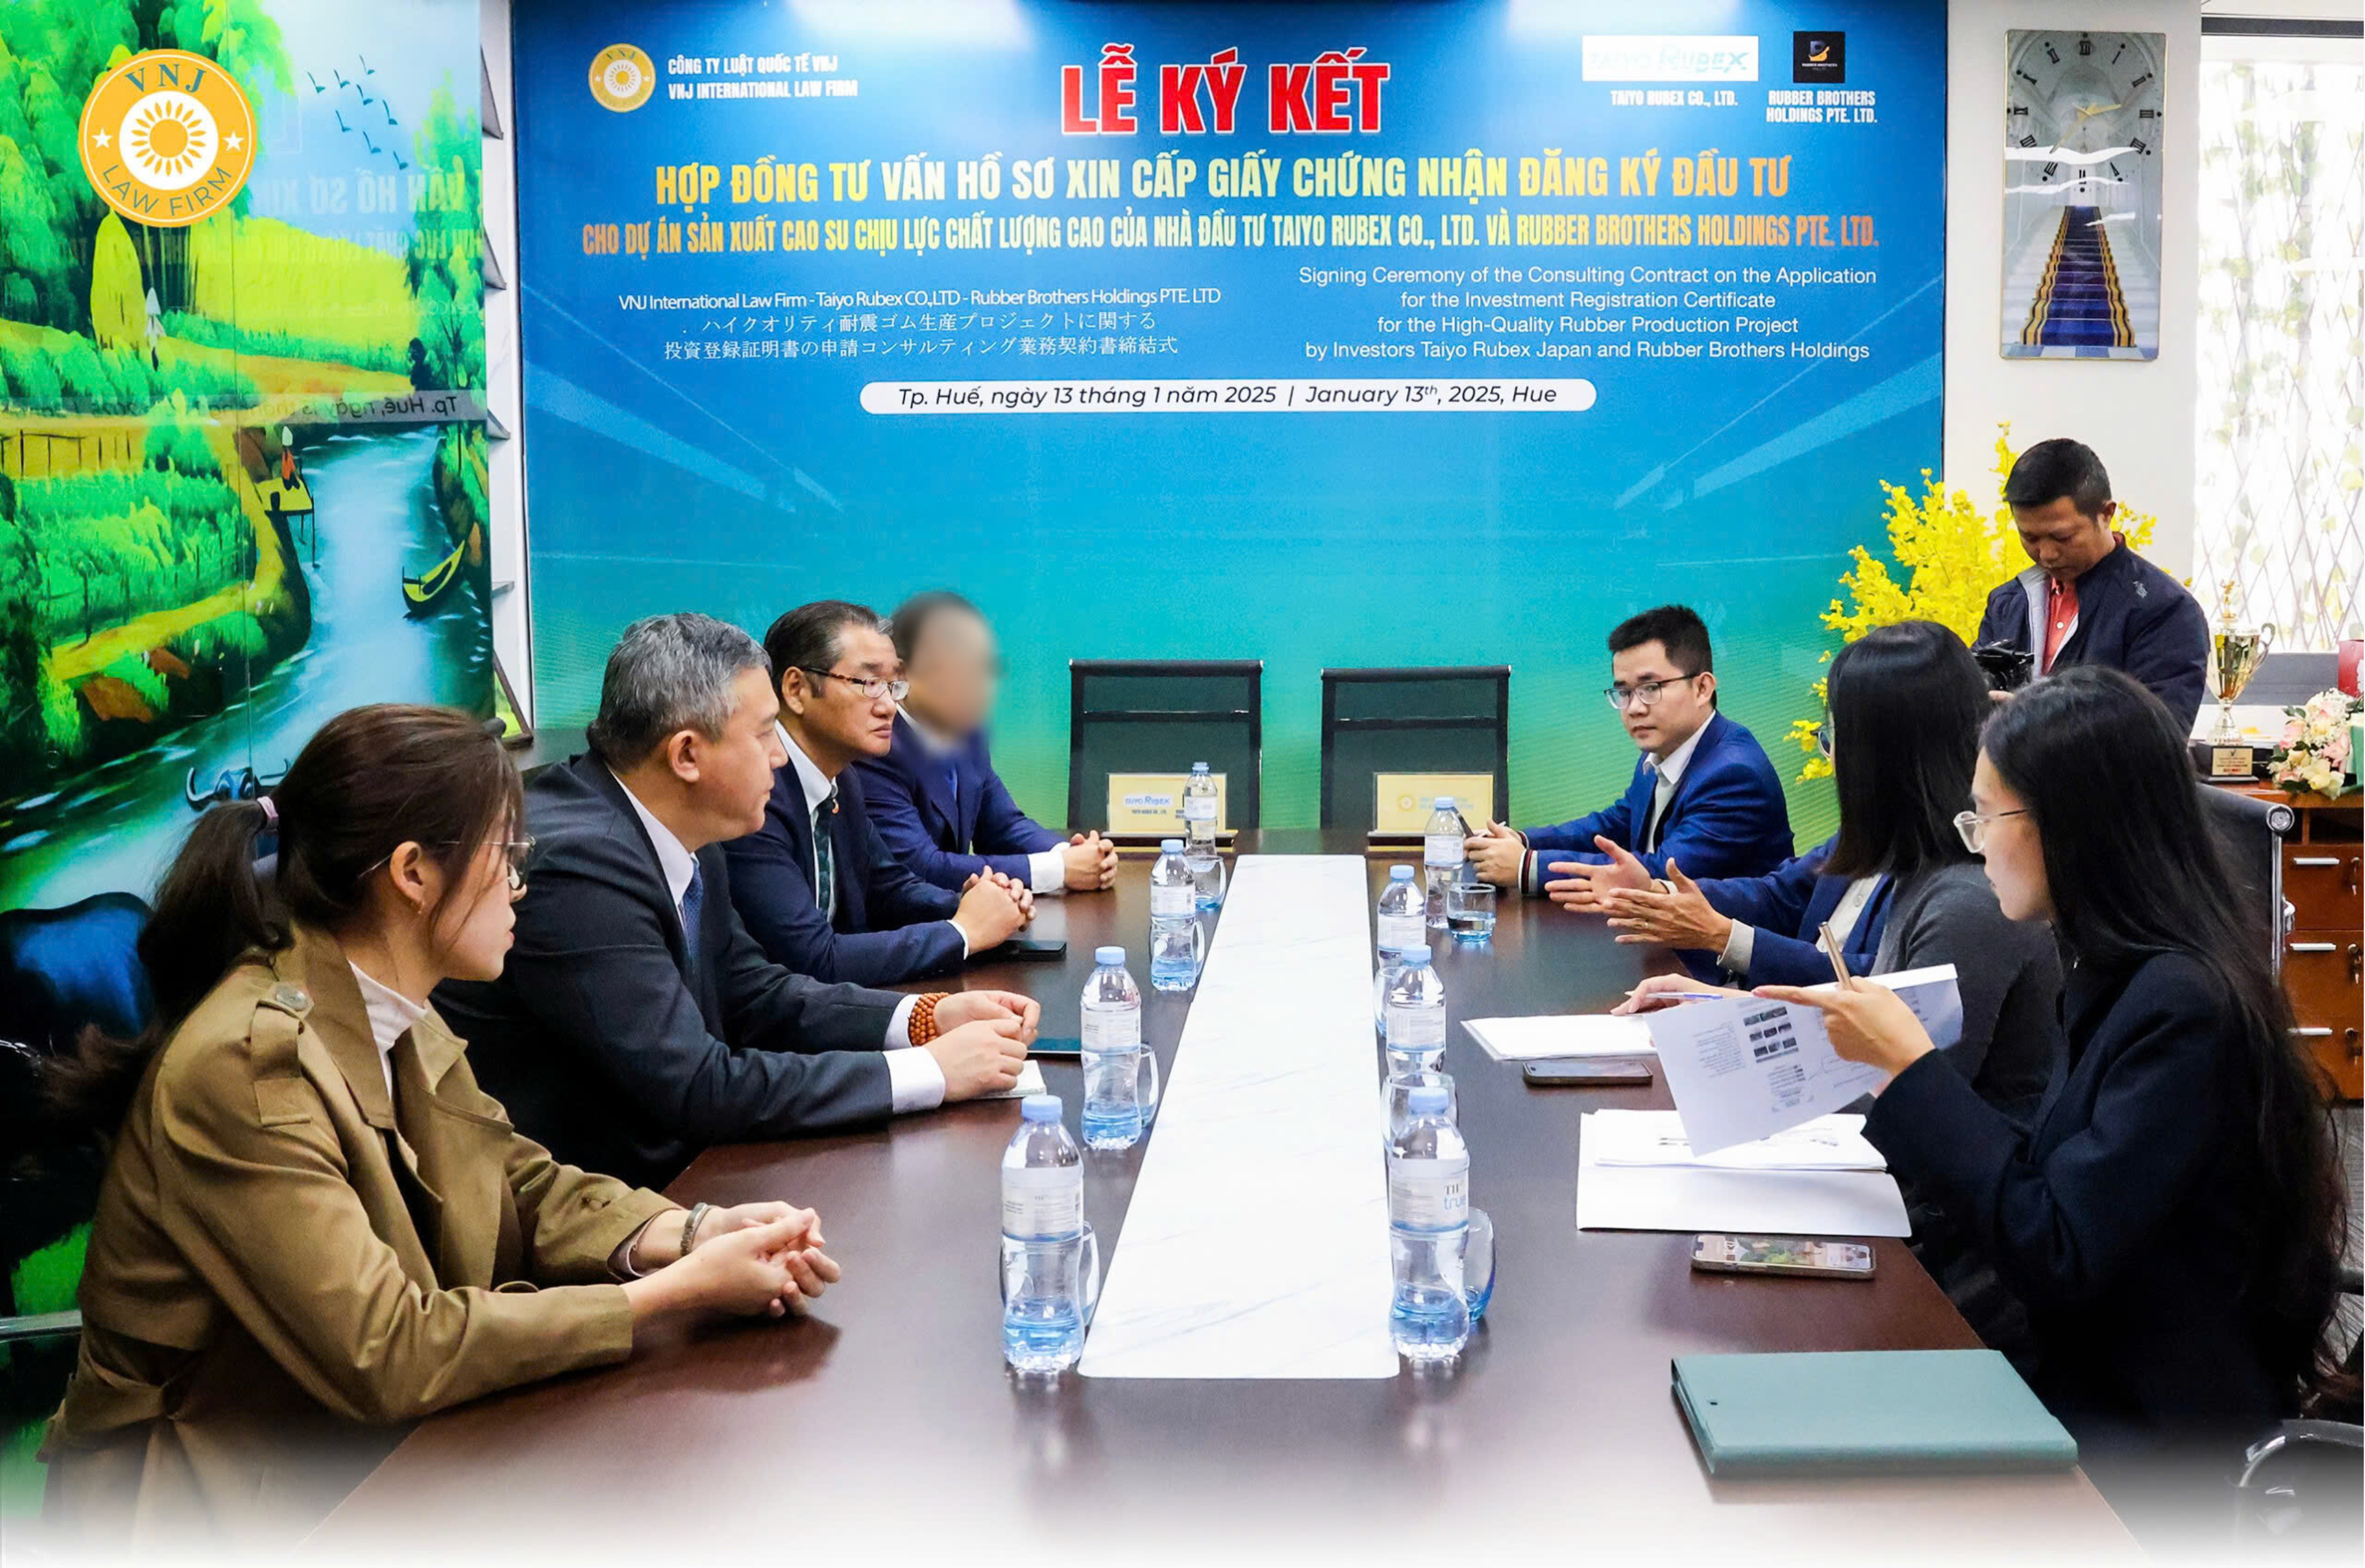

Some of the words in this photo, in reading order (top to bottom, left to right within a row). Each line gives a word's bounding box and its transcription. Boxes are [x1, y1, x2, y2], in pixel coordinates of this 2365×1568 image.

[668, 54, 702, 75] CÔNG
[705, 58, 720, 74] TY
[724, 54, 754, 77] LUẬT
[757, 52, 791, 74] QUỐC
[794, 52, 811, 72] TẾ
[812, 55, 838, 72] VNJ
[668, 83, 693, 99] VNJ
[697, 81, 791, 99] INTERNATIONAL
[794, 81, 822, 97] LAW
[825, 80, 858, 97] FIRM
[1061, 42, 1138, 135] LỄ
[1160, 47, 1247, 136] KÝ
[1268, 47, 1391, 134] KẾT
[1611, 90, 1643, 106] TAIYO
[1647, 90, 1684, 106] RUBEX
[1688, 90, 1711, 108] CO.,
[1714, 90, 1738, 106] LTD.
[1768, 90, 1813, 106] RUBBER
[1817, 90, 1875, 106] BROTHERS
[1766, 107, 1823, 123] HOLDINGS
[1827, 108, 1850, 123] PTE.
[1854, 108, 1877, 123] LTD.
[656, 162, 720, 213] HỢP
[730, 155, 819, 203] ĐỒNG
[828, 159, 871, 201] TƯ
[881, 152, 945, 201] VẤN
[957, 151, 1003, 200] HỒ
[1012, 156, 1054, 200] SƠ
[1066, 159, 1120, 199] XIN
[1132, 149, 1197, 198] CẤP
[1208, 149, 1282, 198] GIẤY
[1293, 150, 1406, 197] CHỨNG
[1418, 148, 1507, 205] NHẬN
[1519, 148, 1608, 196] ĐĂNG
[1620, 147, 1661, 196] KÝ
[1672, 148, 1739, 196] ĐẦU
[1749, 155, 1792, 196] TƯ
[583, 223, 618, 255] CHO
[625, 221, 651, 261] DỰ
[657, 216, 681, 253] ÁN
[687, 211, 724, 253] SẢN
[729, 214, 776, 252] XUẤT
[782, 220, 819, 251] CAO
[825, 219, 849, 251] SU
[855, 219, 897, 257] CHỊU
[904, 216, 940, 256] LỰC
[945, 210, 993, 249] CHẤT
[999, 215, 1061, 255] LƯỢNG
[1067, 216, 1104, 248] CAO
[1110, 206, 1147, 248] CỦA
[1154, 208, 1192, 247] NHÀ
[1198, 208, 1236, 247] ĐẦU
[1242, 213, 1267, 246] TƯ
[1272, 214, 1325, 246] TAIYO
[1332, 214, 1391, 246] RUBEX
[1398, 214, 1434, 250] CO.,
[1441, 214, 1479, 246] LTD.
[1486, 207, 1510, 246] VÀ
[1517, 214, 1590, 246] RUBBER
[1596, 214, 1691, 246] BROTHERS
[1698, 214, 1790, 246] HOLDINGS
[1796, 214, 1835, 247] PTE.
[1841, 215, 1879, 247] LTD.
[1300, 267, 1366, 286] Signing
[1373, 267, 1465, 286] Ceremony
[1471, 267, 1488, 282] of
[1494, 267, 1522, 282] the
[1529, 266, 1624, 286] Consulting
[1630, 266, 1708, 283] Contract
[1714, 270, 1736, 283] on
[1743, 267, 1770, 283] the
[1776, 267, 1876, 287] Application
[619, 295, 647, 310] VNJ
[650, 293, 739, 309] International
[742, 294, 772, 309] Law
[775, 293, 807, 308] Firm
[817, 292, 854, 310] Taiyo
[857, 291, 902, 307] Rubex
[971, 289, 1025, 305] Rubber
[1029, 289, 1089, 305] Brothers
[1091, 288, 1157, 307] Holdings
[1160, 288, 1190, 304] PTE.
[1193, 288, 1221, 304] LTD
[1401, 292, 1426, 307] for
[1431, 292, 1459, 307] the
[1466, 292, 1564, 307] Investment
[1571, 291, 1677, 310] Registration
[1684, 291, 1775, 307] Certificate
[703, 312, 1155, 333] ハイクオリティ耐震ゴム生産プロジェクトに関する
[1378, 317, 1402, 332] for
[1407, 317, 1436, 332] the
[1442, 317, 1554, 336] High-Quality
[1560, 317, 1626, 332] Rubber
[1633, 317, 1729, 332] Production
[1736, 317, 1798, 336] Project
[665, 335, 1178, 360] 投資登録証明書の申請コンサルティング業務契約書締結式
[1306, 342, 1327, 361] by
[1334, 342, 1415, 357] Investors
[1420, 341, 1466, 360] Taiyo
[1474, 341, 1530, 357] Rubex
[1537, 341, 1591, 361] Japan
[1598, 341, 1631, 357] and
[1638, 341, 1703, 357] Rubber
[1710, 341, 1785, 357] Brothers
[1792, 342, 1869, 361] Holdings
[900, 389, 927, 408] Tp.
[936, 389, 983, 406] Huế,
[992, 387, 1047, 408] ngày
[1054, 388, 1073, 403] 13
[1080, 387, 1146, 407] tháng
[1155, 387, 1160, 402] 1
[1167, 387, 1217, 403] năm
[1225, 387, 1276, 402] 2025
[1306, 387, 1398, 406] January
[1449, 386, 1503, 405] 2025,
[1513, 386, 1556, 402] Hue
